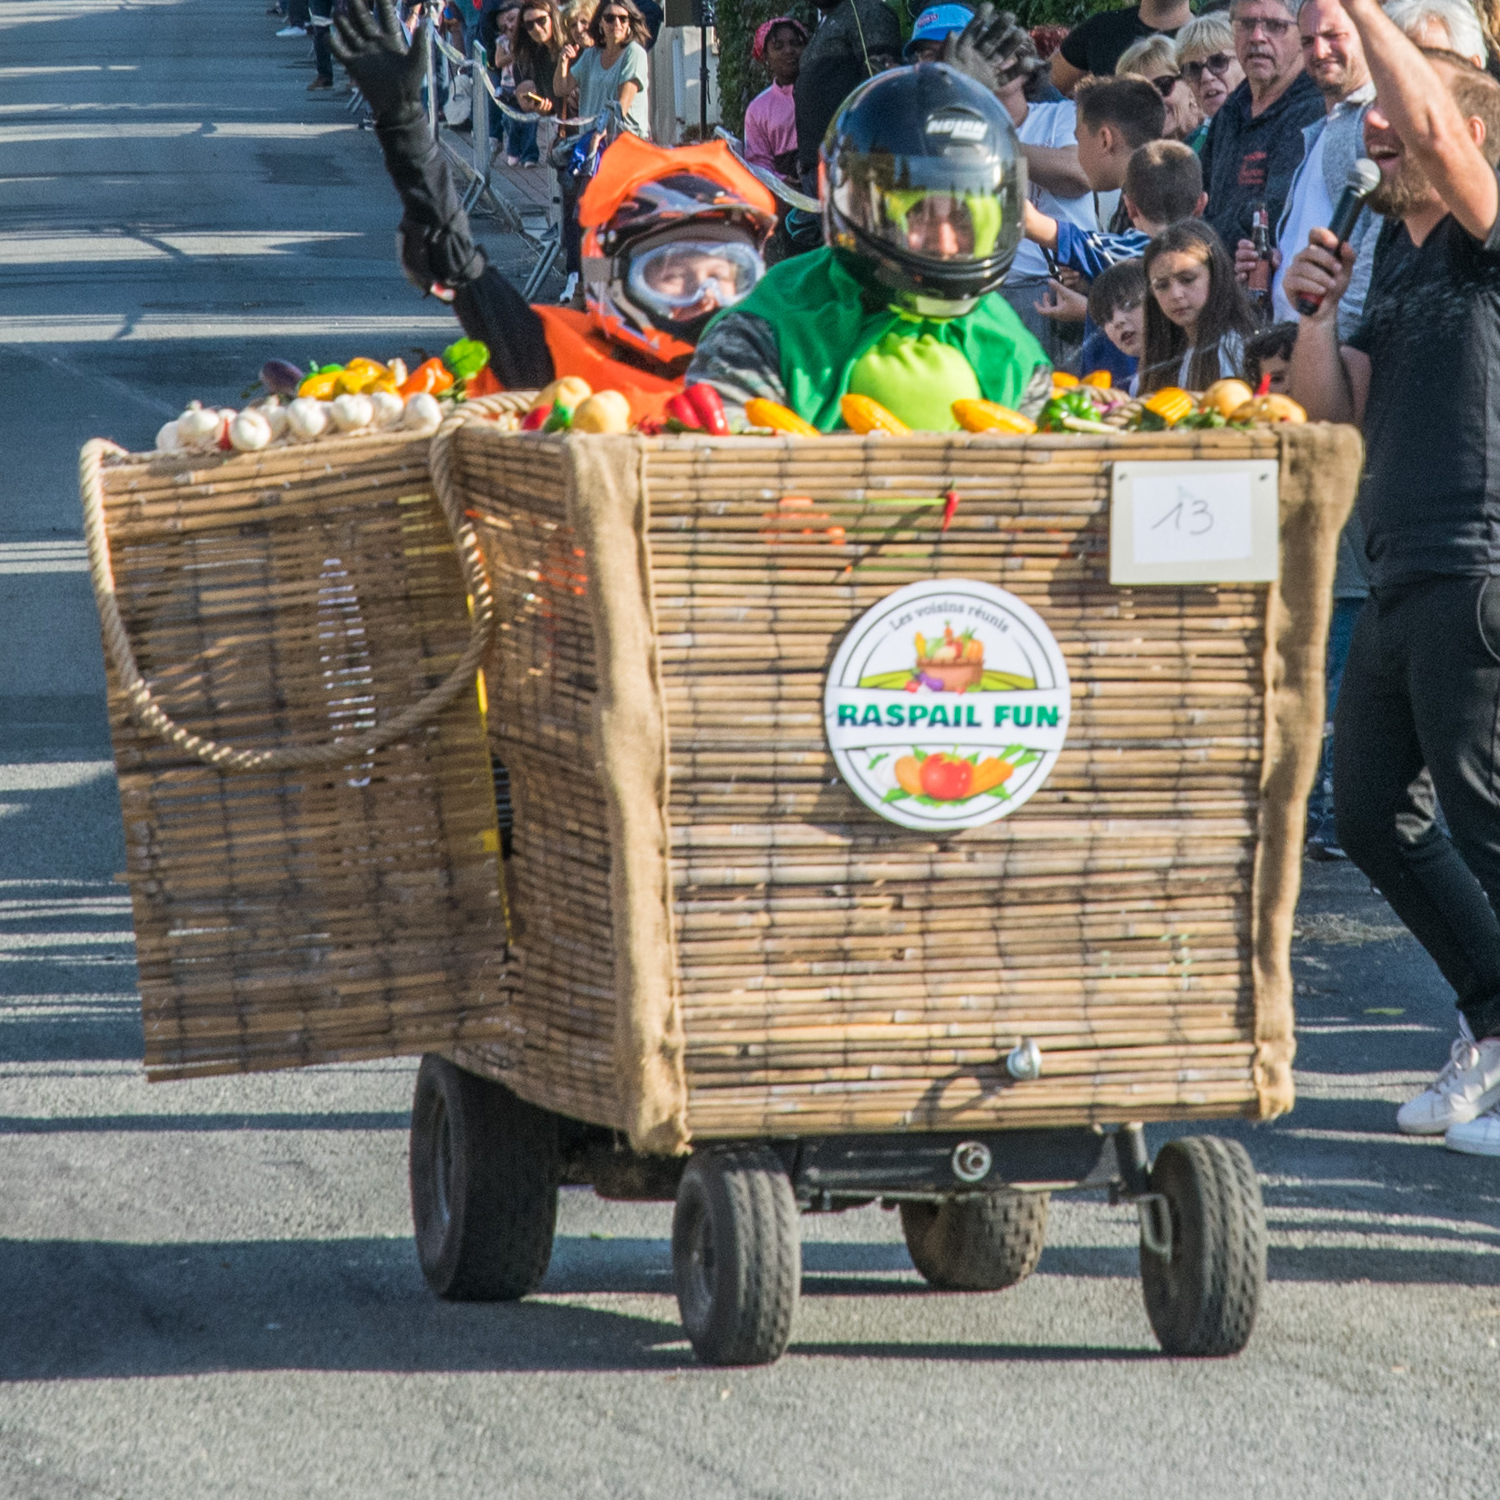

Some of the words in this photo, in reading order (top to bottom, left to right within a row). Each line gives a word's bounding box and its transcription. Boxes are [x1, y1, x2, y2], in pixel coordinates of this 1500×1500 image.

[1151, 499, 1214, 536] 13
[889, 611, 913, 632] Les
[915, 600, 966, 618] voisins
[967, 603, 1010, 634] réunis
[837, 703, 983, 728] RASPAIL
[993, 704, 1059, 728] FUN
